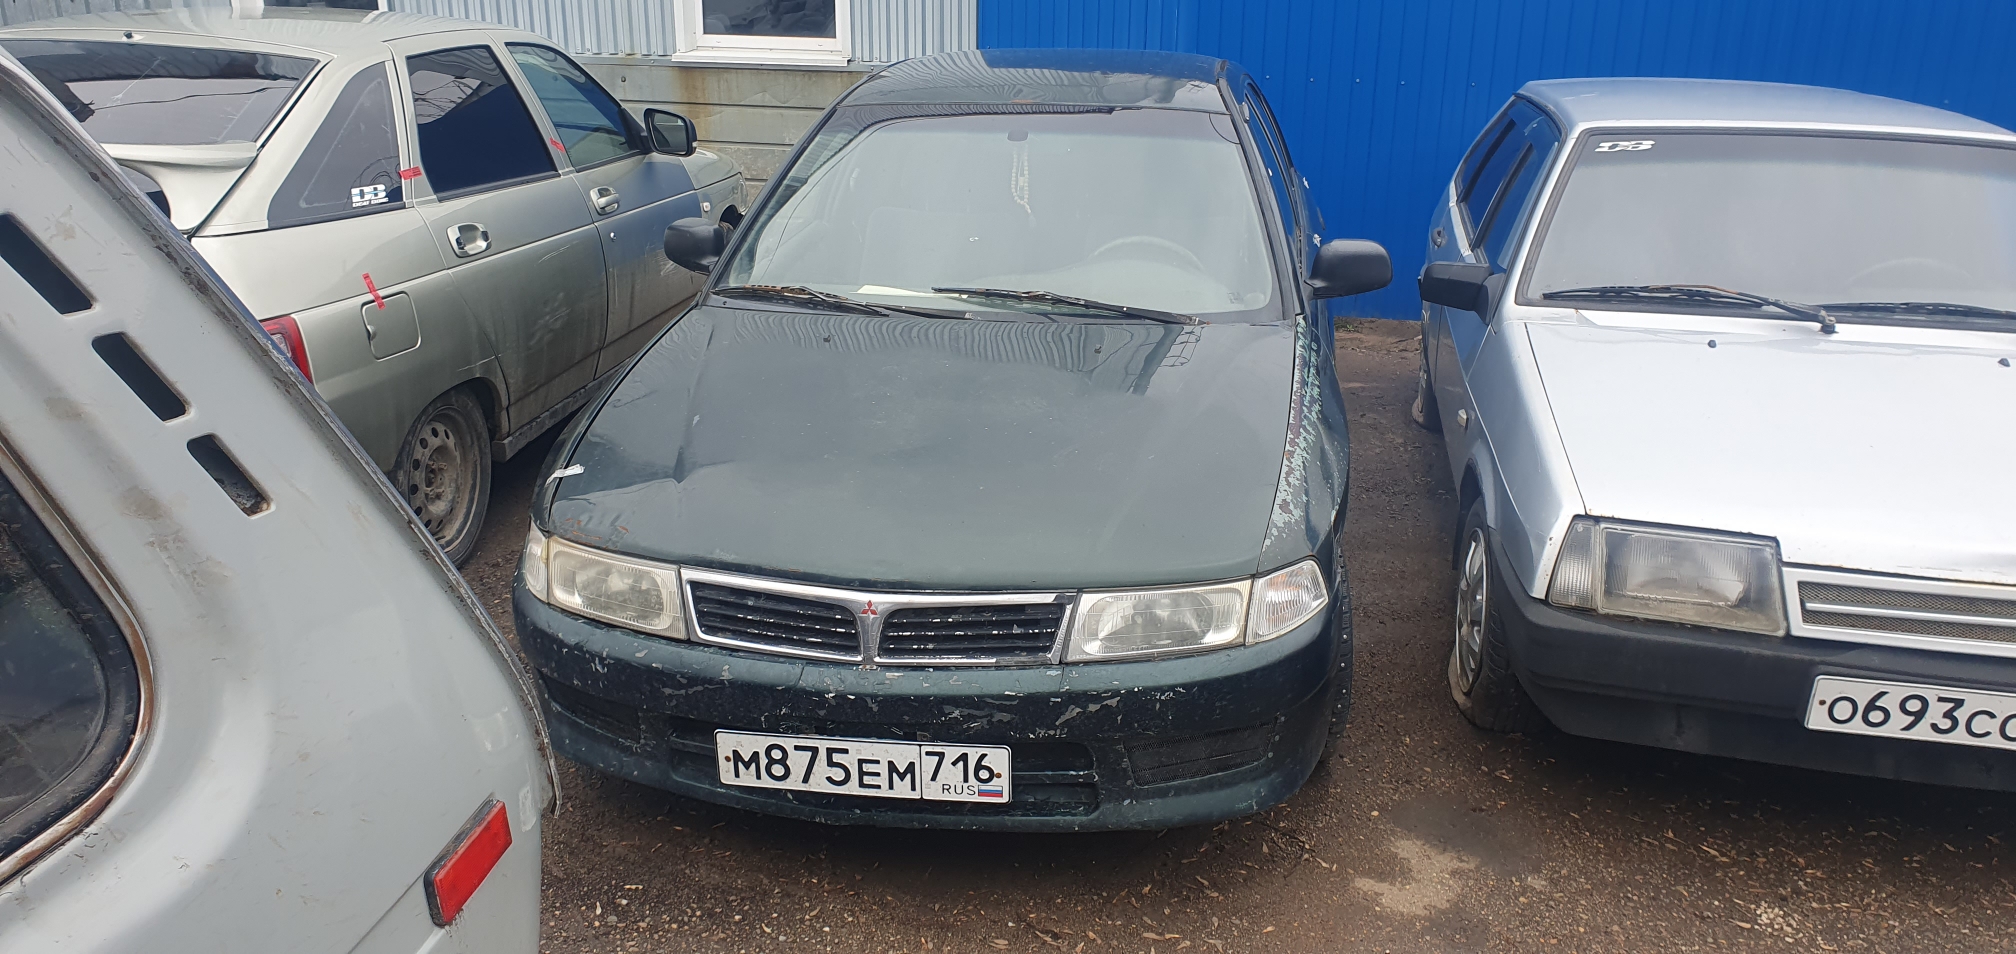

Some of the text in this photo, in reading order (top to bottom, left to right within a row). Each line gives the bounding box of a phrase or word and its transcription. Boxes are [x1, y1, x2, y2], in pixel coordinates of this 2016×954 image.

[351, 184, 387, 203] DB
[732, 743, 996, 792] М875ЕМ 716
[941, 784, 976, 796] RUS
